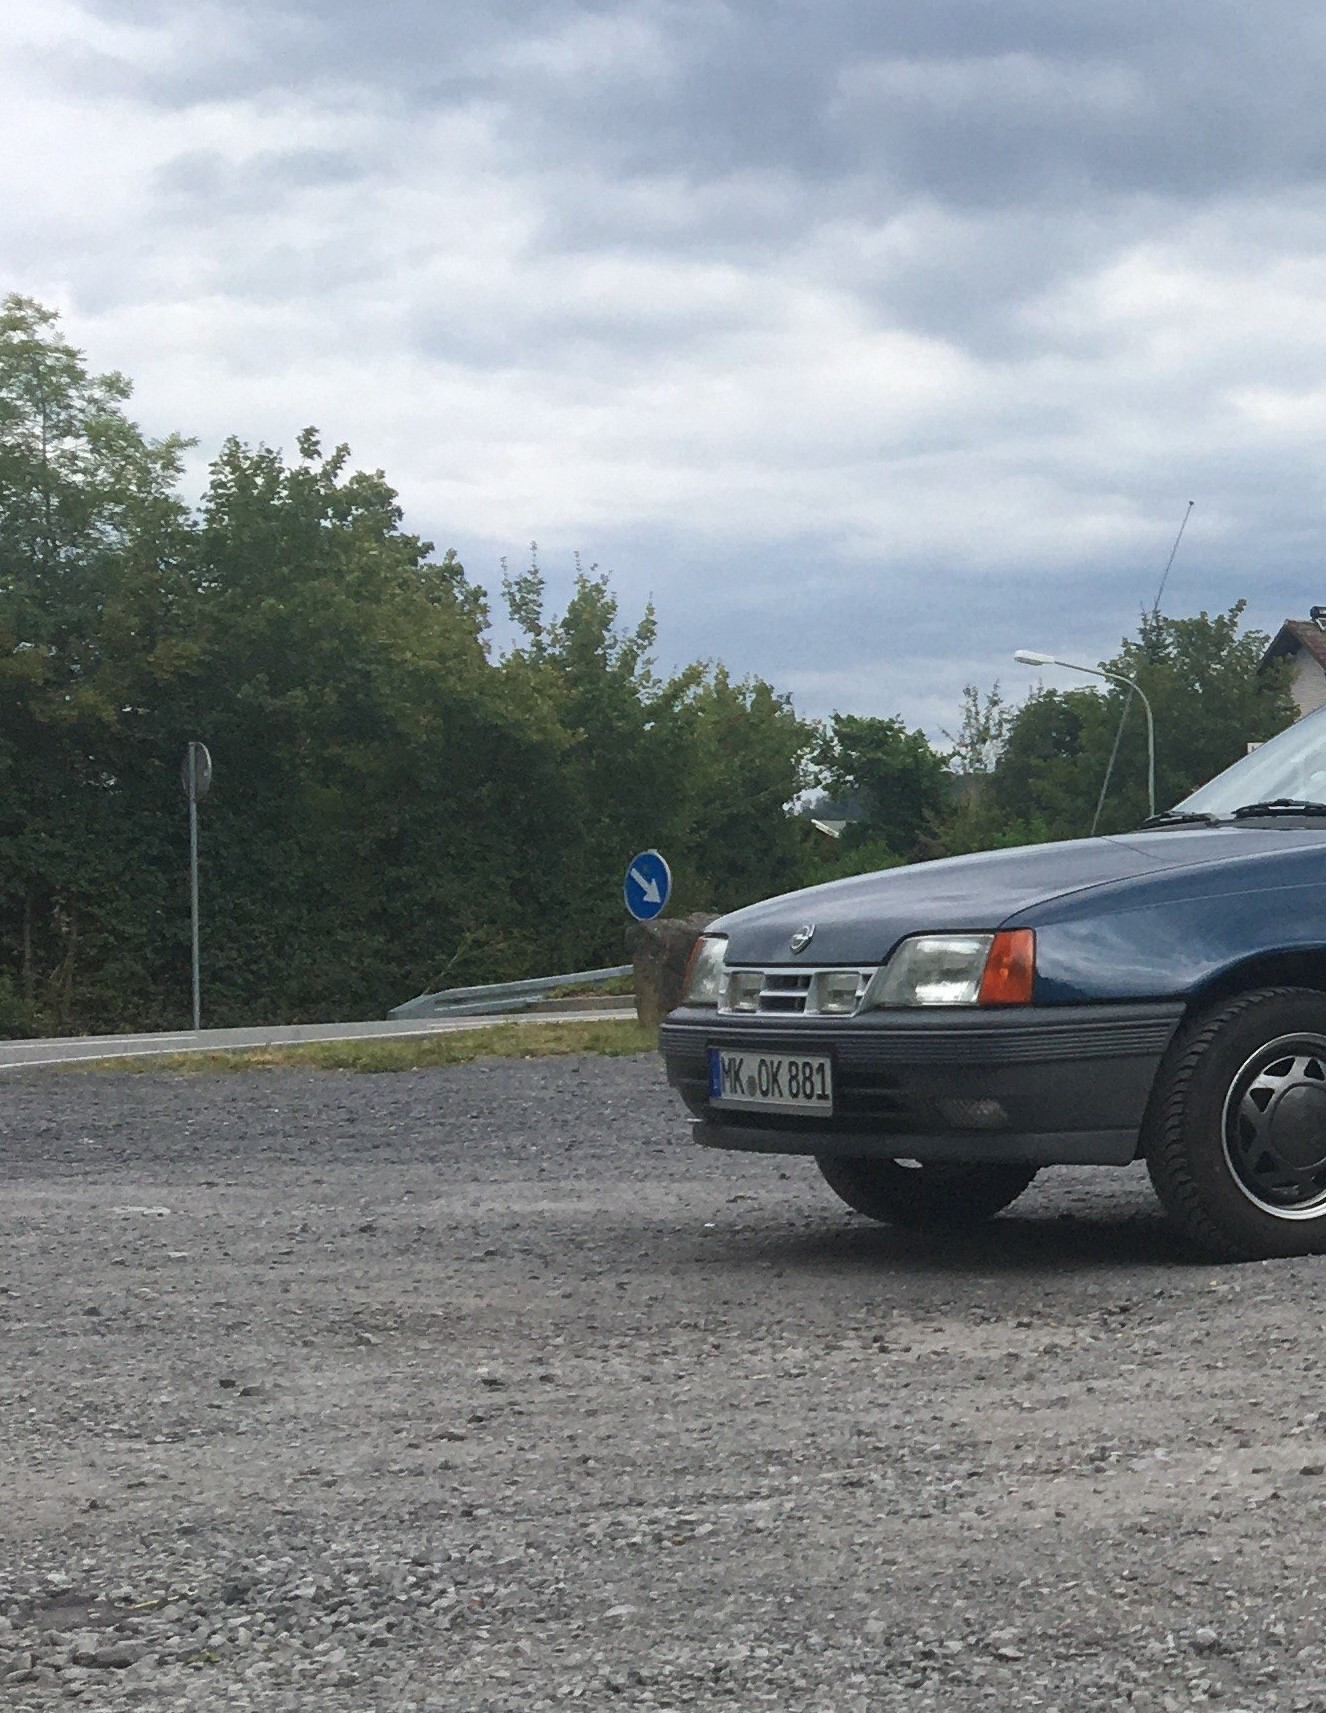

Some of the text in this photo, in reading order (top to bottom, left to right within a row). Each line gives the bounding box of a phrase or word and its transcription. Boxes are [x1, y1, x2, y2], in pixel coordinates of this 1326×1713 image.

[721, 1057, 830, 1101] MK OK 881
